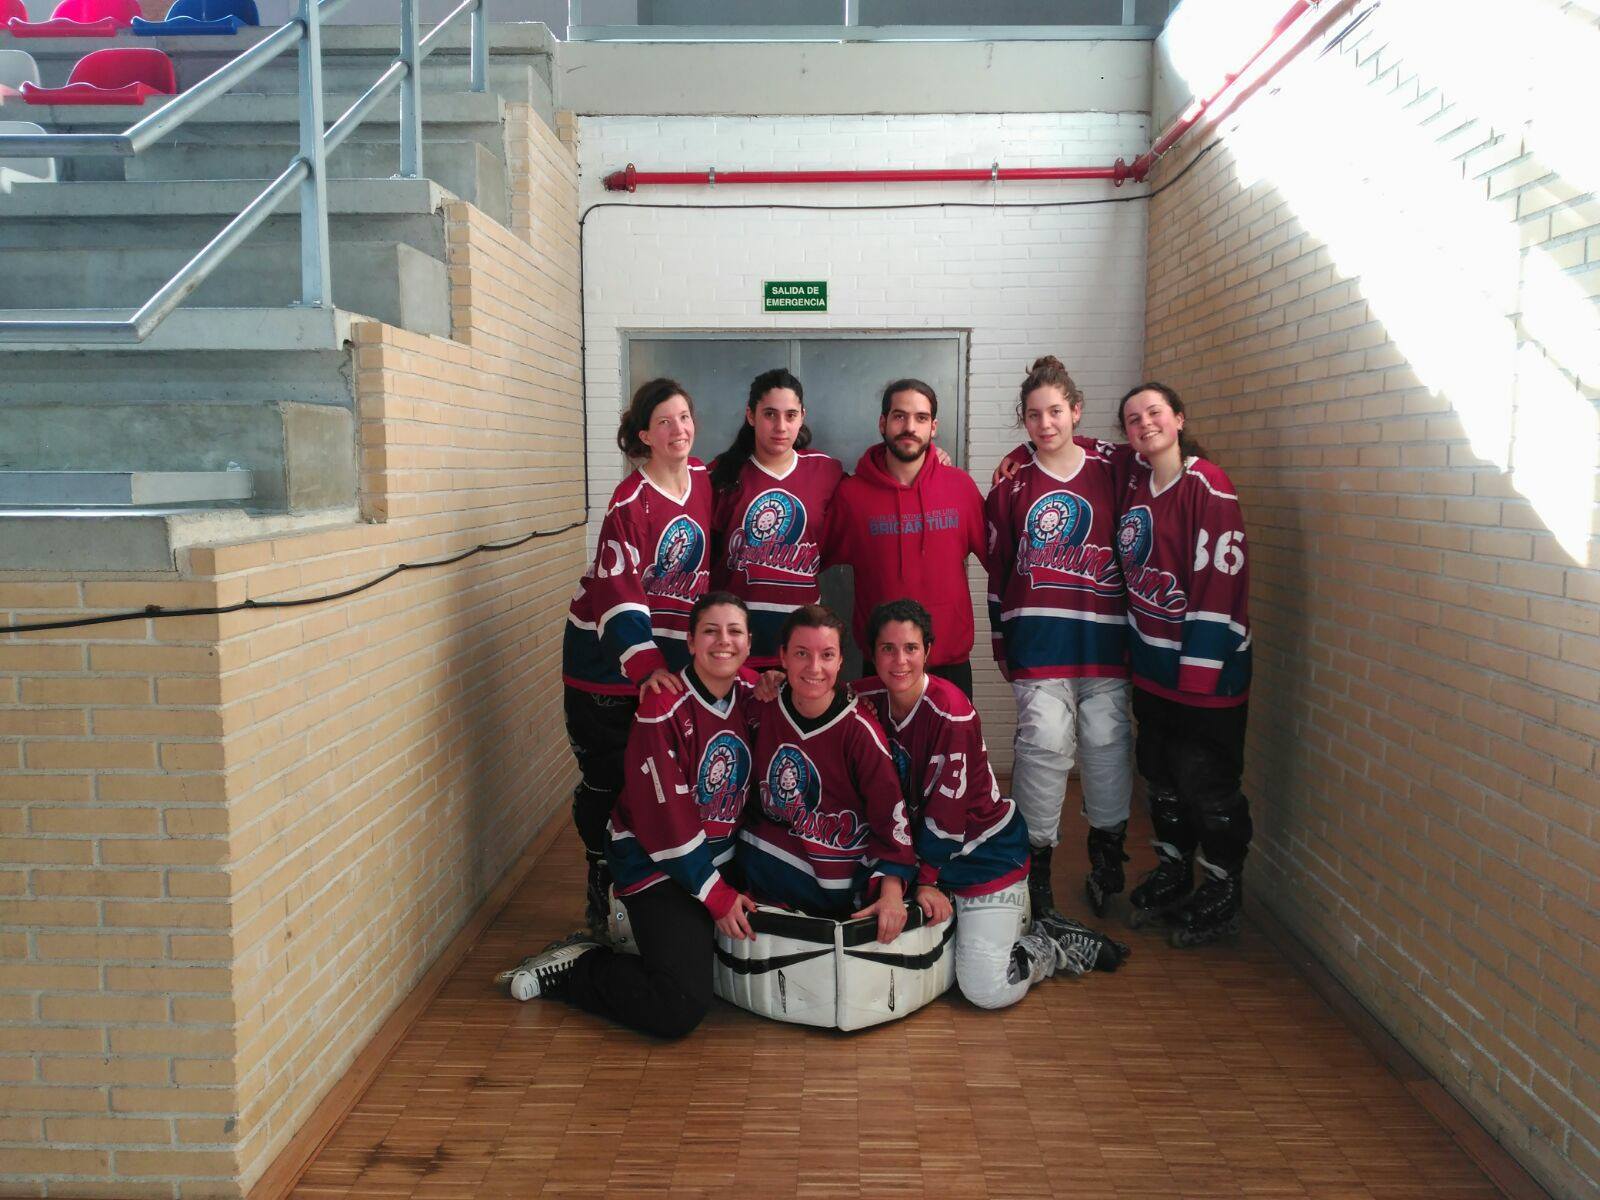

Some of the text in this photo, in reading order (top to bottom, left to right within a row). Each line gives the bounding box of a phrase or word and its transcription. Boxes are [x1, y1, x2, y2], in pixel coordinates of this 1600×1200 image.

[766, 298, 826, 307] EMERGENCIA
[772, 286, 819, 295] SALIDA DE
[640, 749, 689, 804] 1
[923, 753, 967, 800] 73
